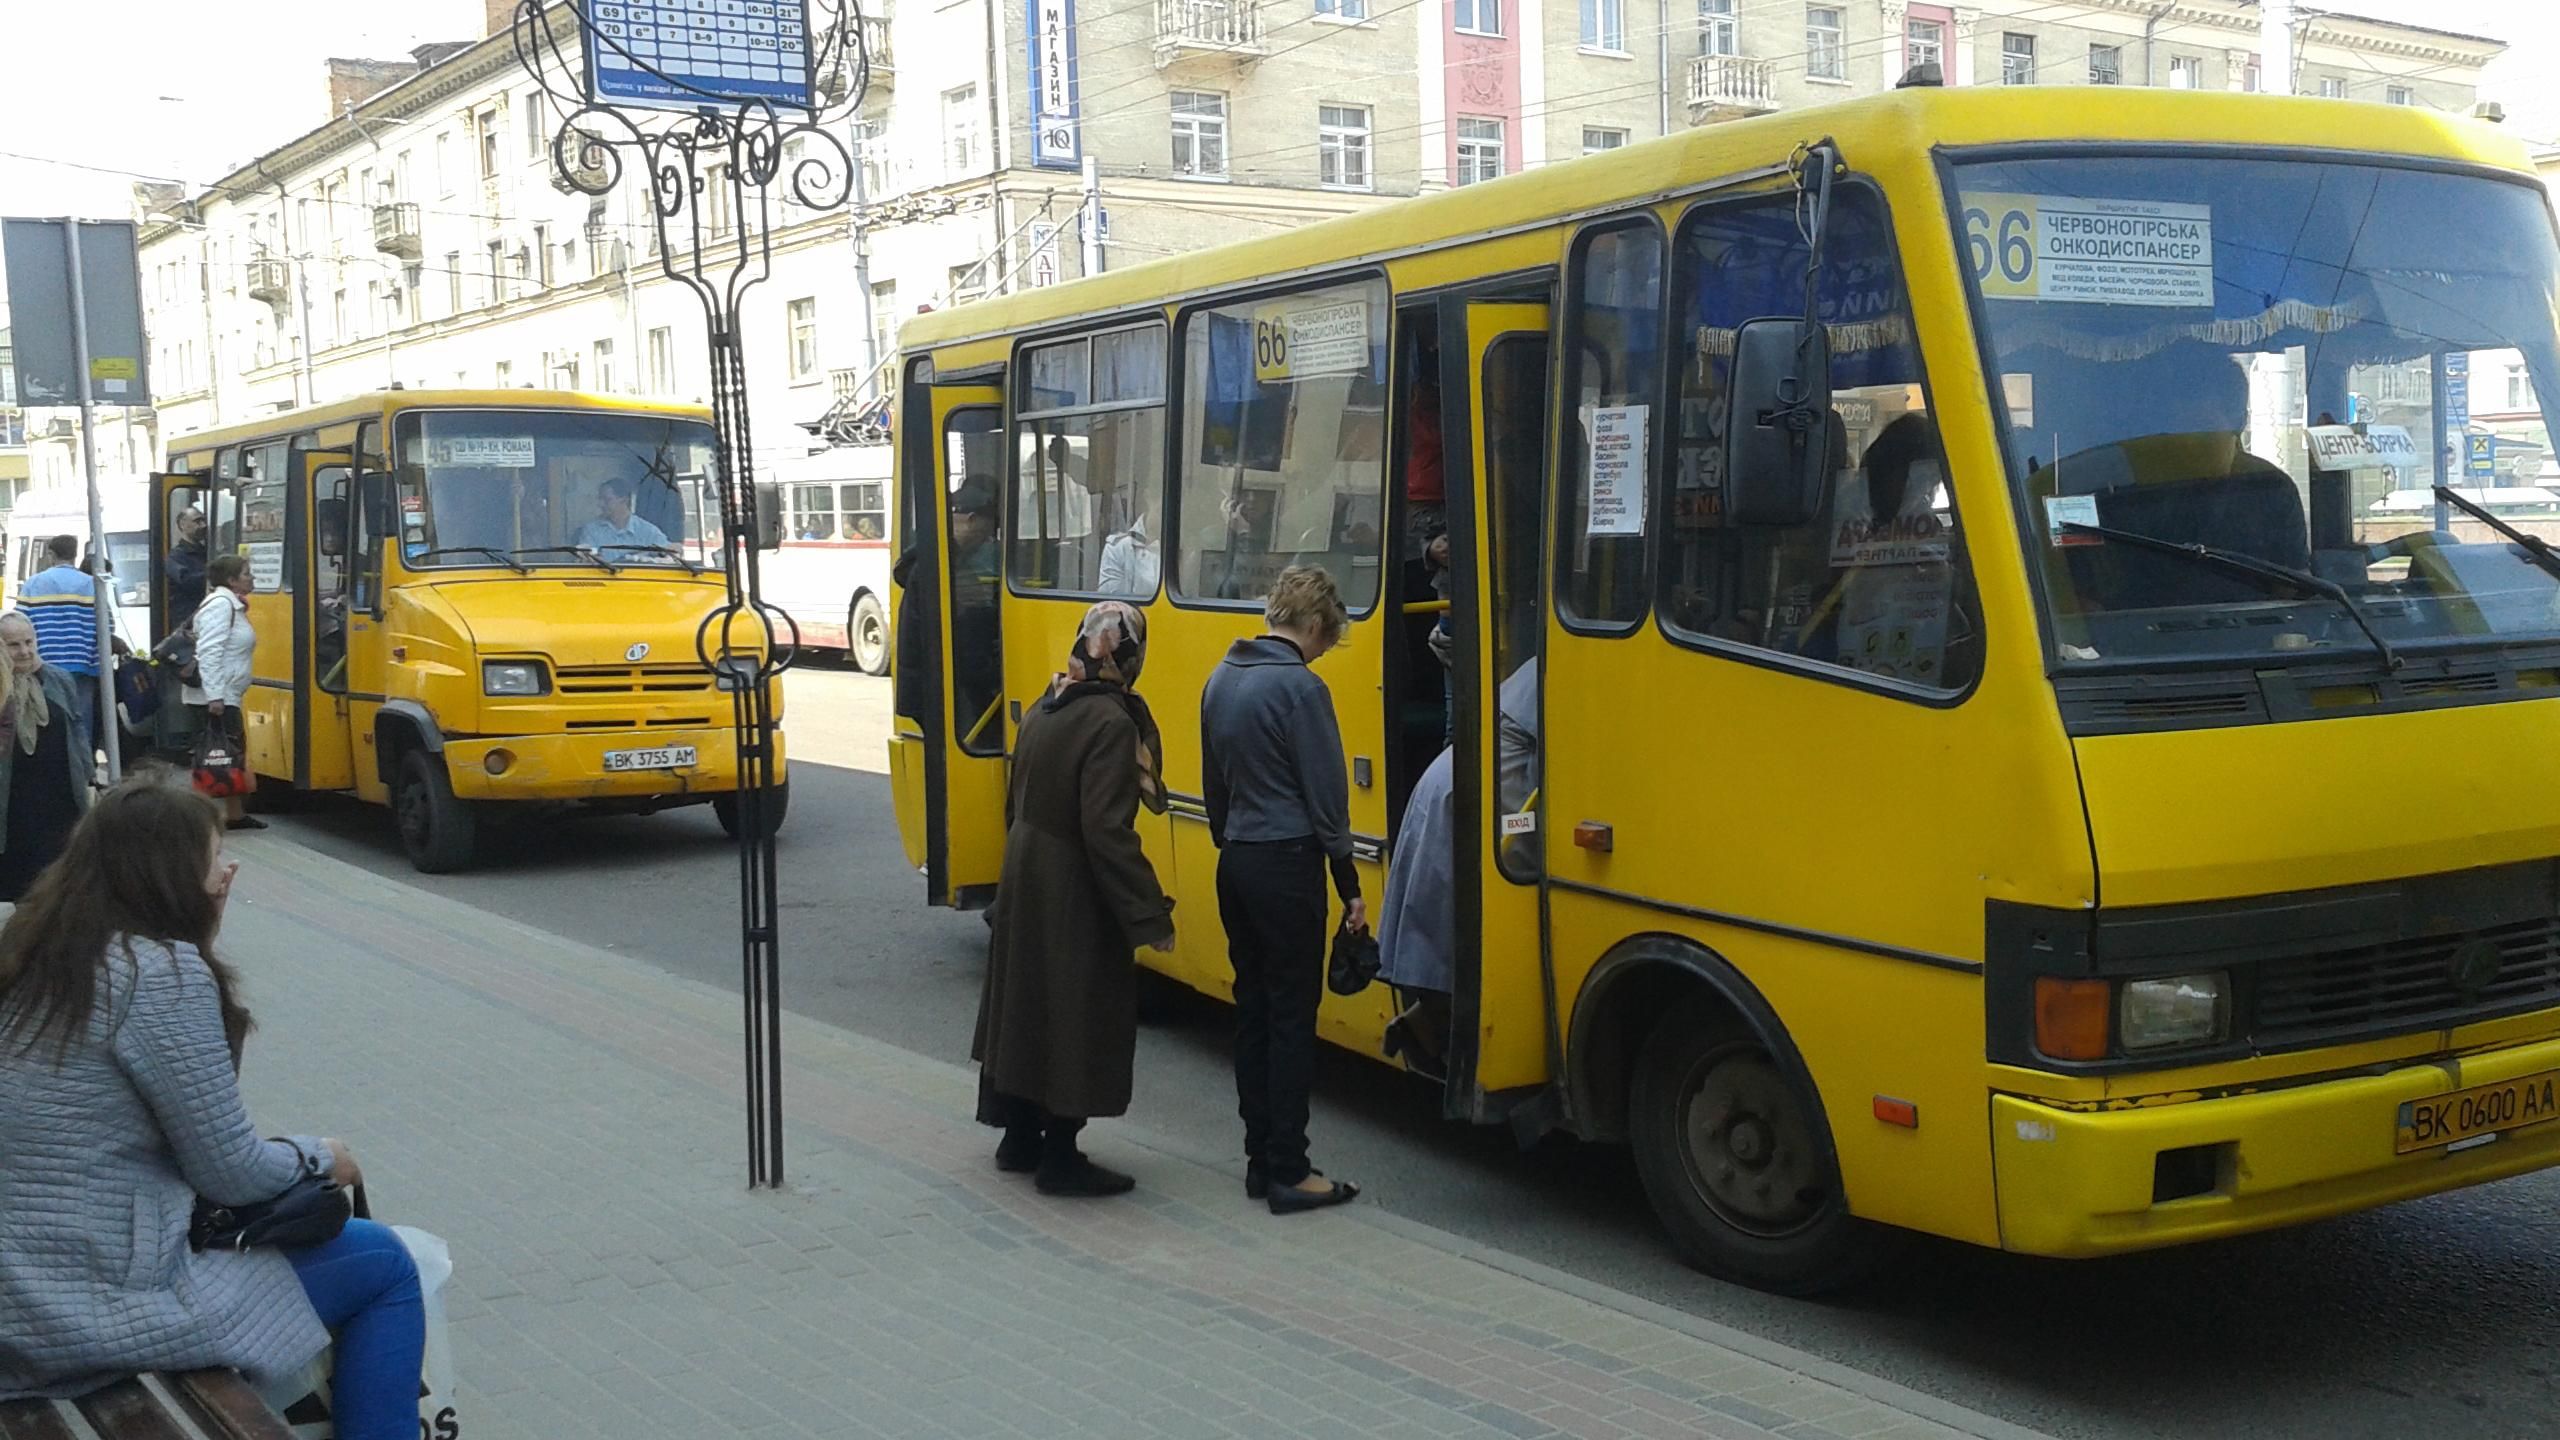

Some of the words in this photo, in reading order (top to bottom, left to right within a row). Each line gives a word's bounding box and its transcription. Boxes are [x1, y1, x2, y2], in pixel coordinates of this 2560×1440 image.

[603, 7, 619, 17] 69
[668, 14, 675, 22] 9
[758, 22, 765, 30] 9
[748, 5, 773, 14] 10-12
[604, 24, 620, 34] 70
[670, 31, 676, 39] 7
[730, 36, 736, 44] 7
[750, 38, 776, 47] 10-12
[1046, 8, 1061, 107] МАГАЗИН
[2048, 216, 2199, 240] ЧЕРВОНОГІРСЬКА
[1963, 208, 2032, 282] 66
[2050, 237, 2201, 259] ОНКОДИСПАНСЕР
[1258, 315, 1286, 368] 66
[2315, 433, 2416, 460] ЦЕНТР-БОЯРКА
[638, 750, 669, 766] 3755
[675, 749, 695, 764] AM
[2460, 1086, 2516, 1132] 0600
[2522, 1077, 2556, 1118] AA
